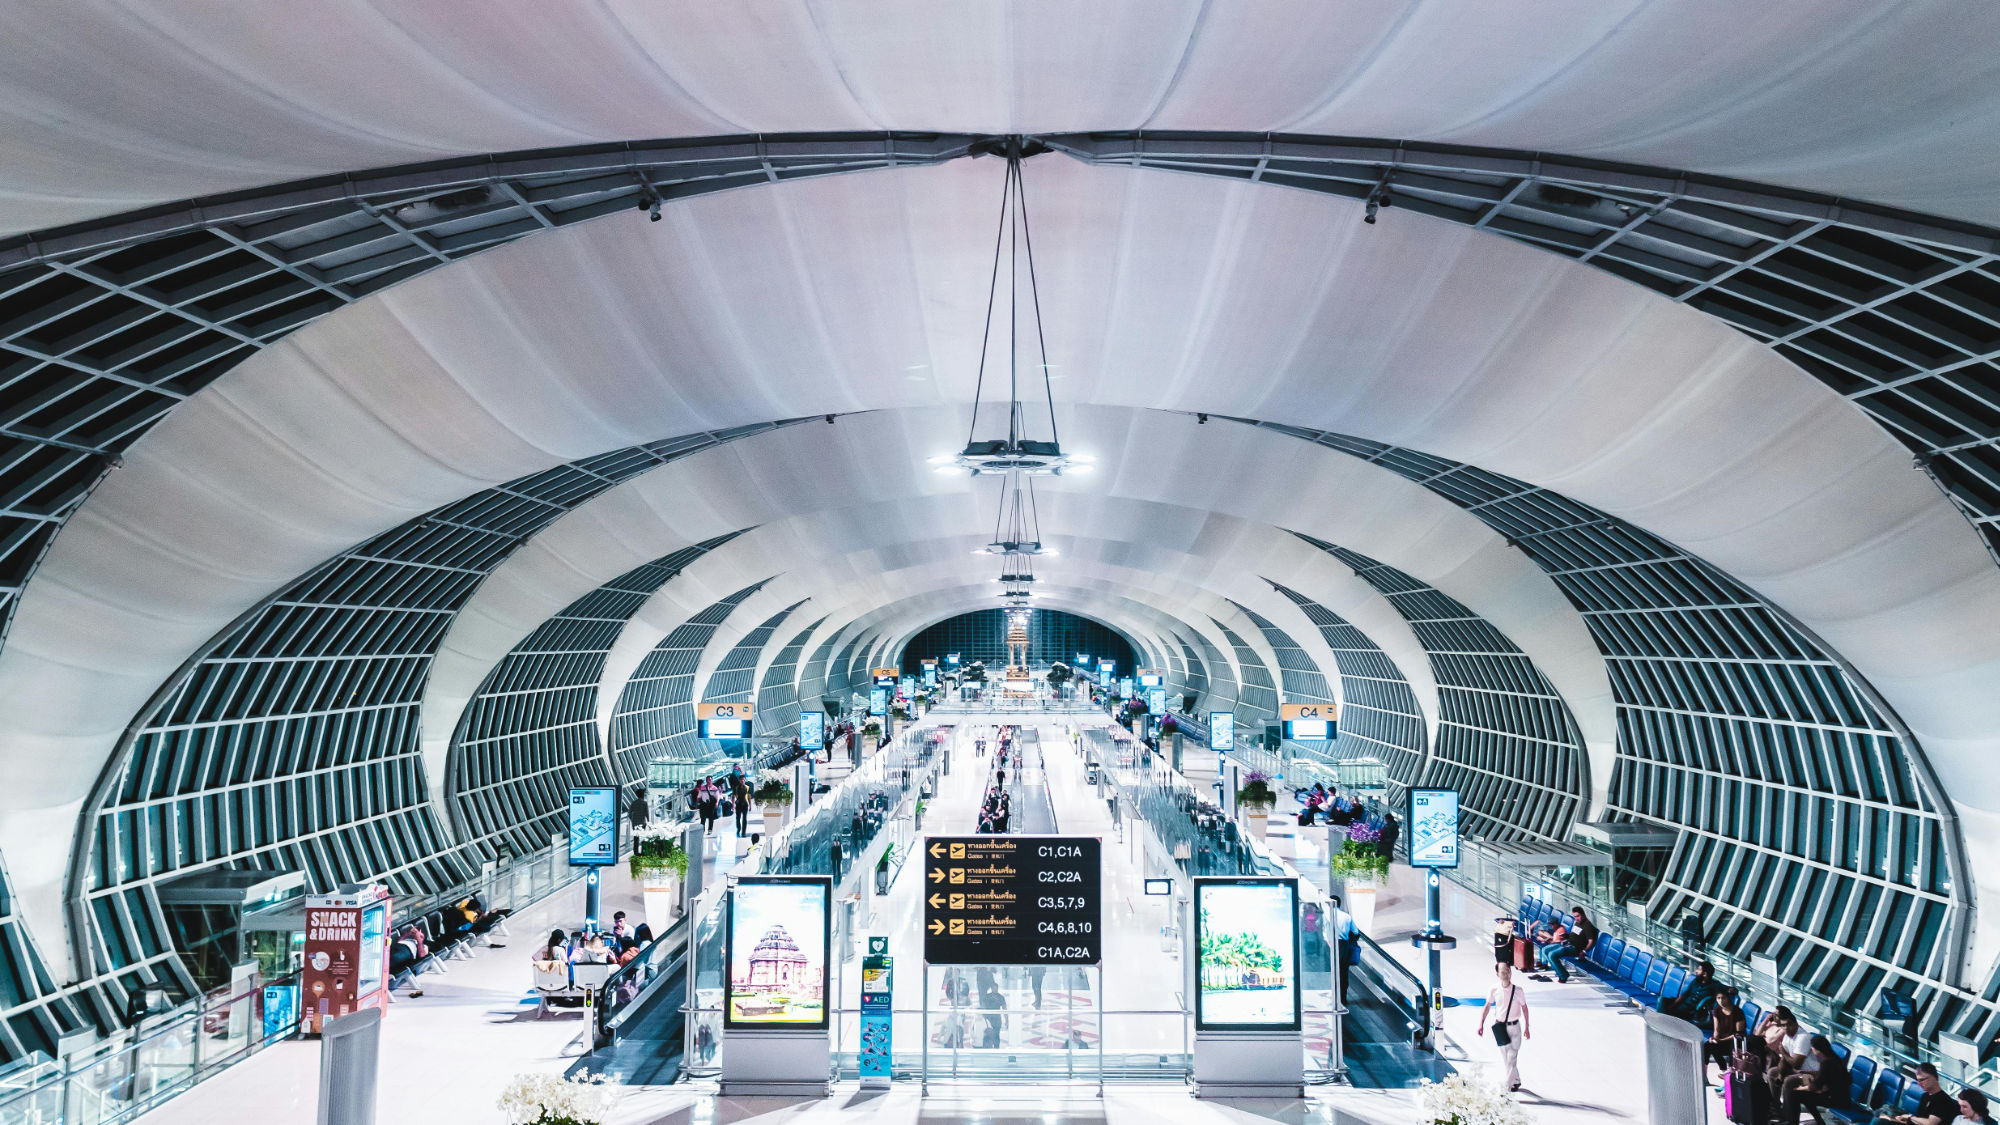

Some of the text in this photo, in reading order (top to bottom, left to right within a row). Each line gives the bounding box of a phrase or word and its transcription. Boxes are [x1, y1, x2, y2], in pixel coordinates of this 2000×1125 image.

[716, 705, 734, 717] C3
[1300, 706, 1318, 718] C4
[1038, 846, 1082, 858] C1,C1A
[1038, 871, 1082, 883] C2,C2A
[1038, 897, 1085, 909] C3,5,7,9
[311, 912, 357, 927] SNACK
[1038, 922, 1092, 934] C4,6,8,10
[1038, 947, 1090, 959] C1A,C2A
